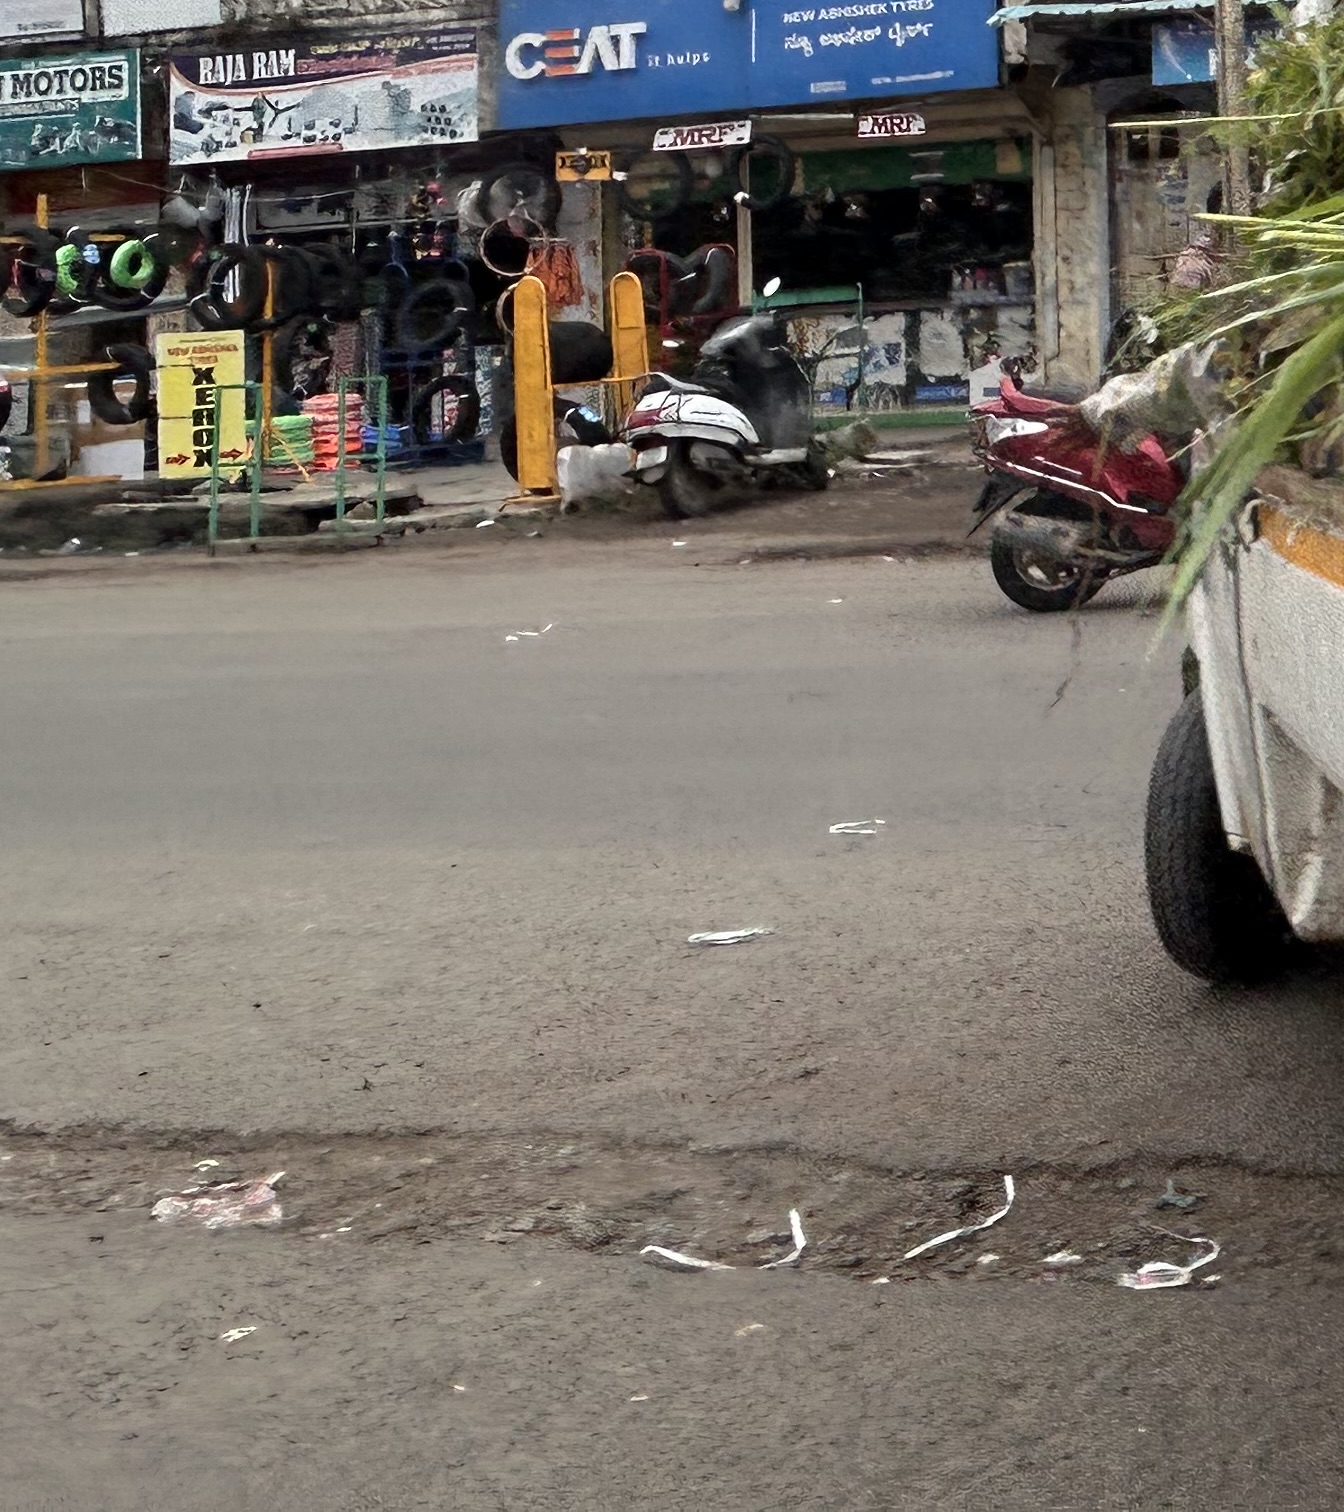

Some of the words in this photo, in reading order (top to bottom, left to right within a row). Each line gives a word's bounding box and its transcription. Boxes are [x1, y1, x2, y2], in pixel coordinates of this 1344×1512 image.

[783, 9, 815, 24] NEW
[199, 53, 246, 86] RAJA
[252, 49, 295, 80] RAM
[505, 21, 647, 79] CEAT
[11, 65, 123, 99] MOTORS
[672, 124, 735, 146] MRF
[191, 366, 216, 468] XEROX
